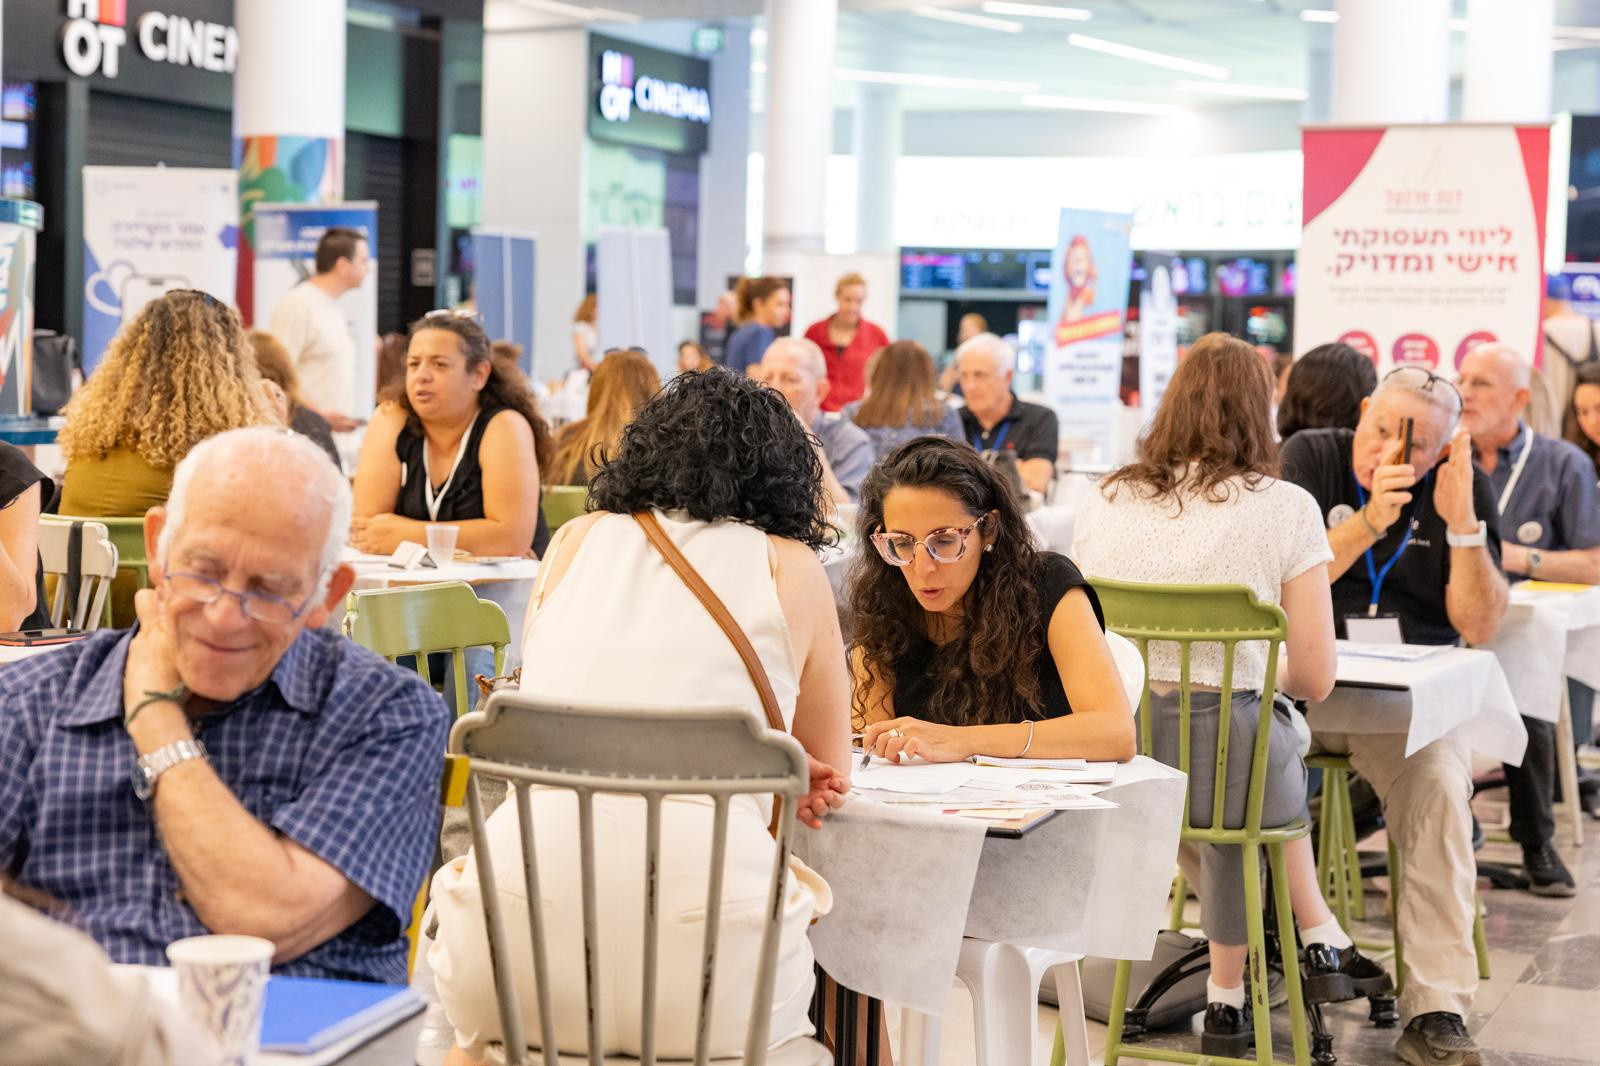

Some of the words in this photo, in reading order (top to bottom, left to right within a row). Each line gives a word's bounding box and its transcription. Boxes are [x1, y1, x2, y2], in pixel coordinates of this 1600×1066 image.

[139, 11, 238, 73] CINE
[635, 76, 711, 123] CINEMA
[1333, 228, 1449, 248] תעסוקתי
[1457, 225, 1513, 245] ליווי
[1325, 252, 1434, 277] ומדויק.
[1445, 252, 1519, 272] אישי
